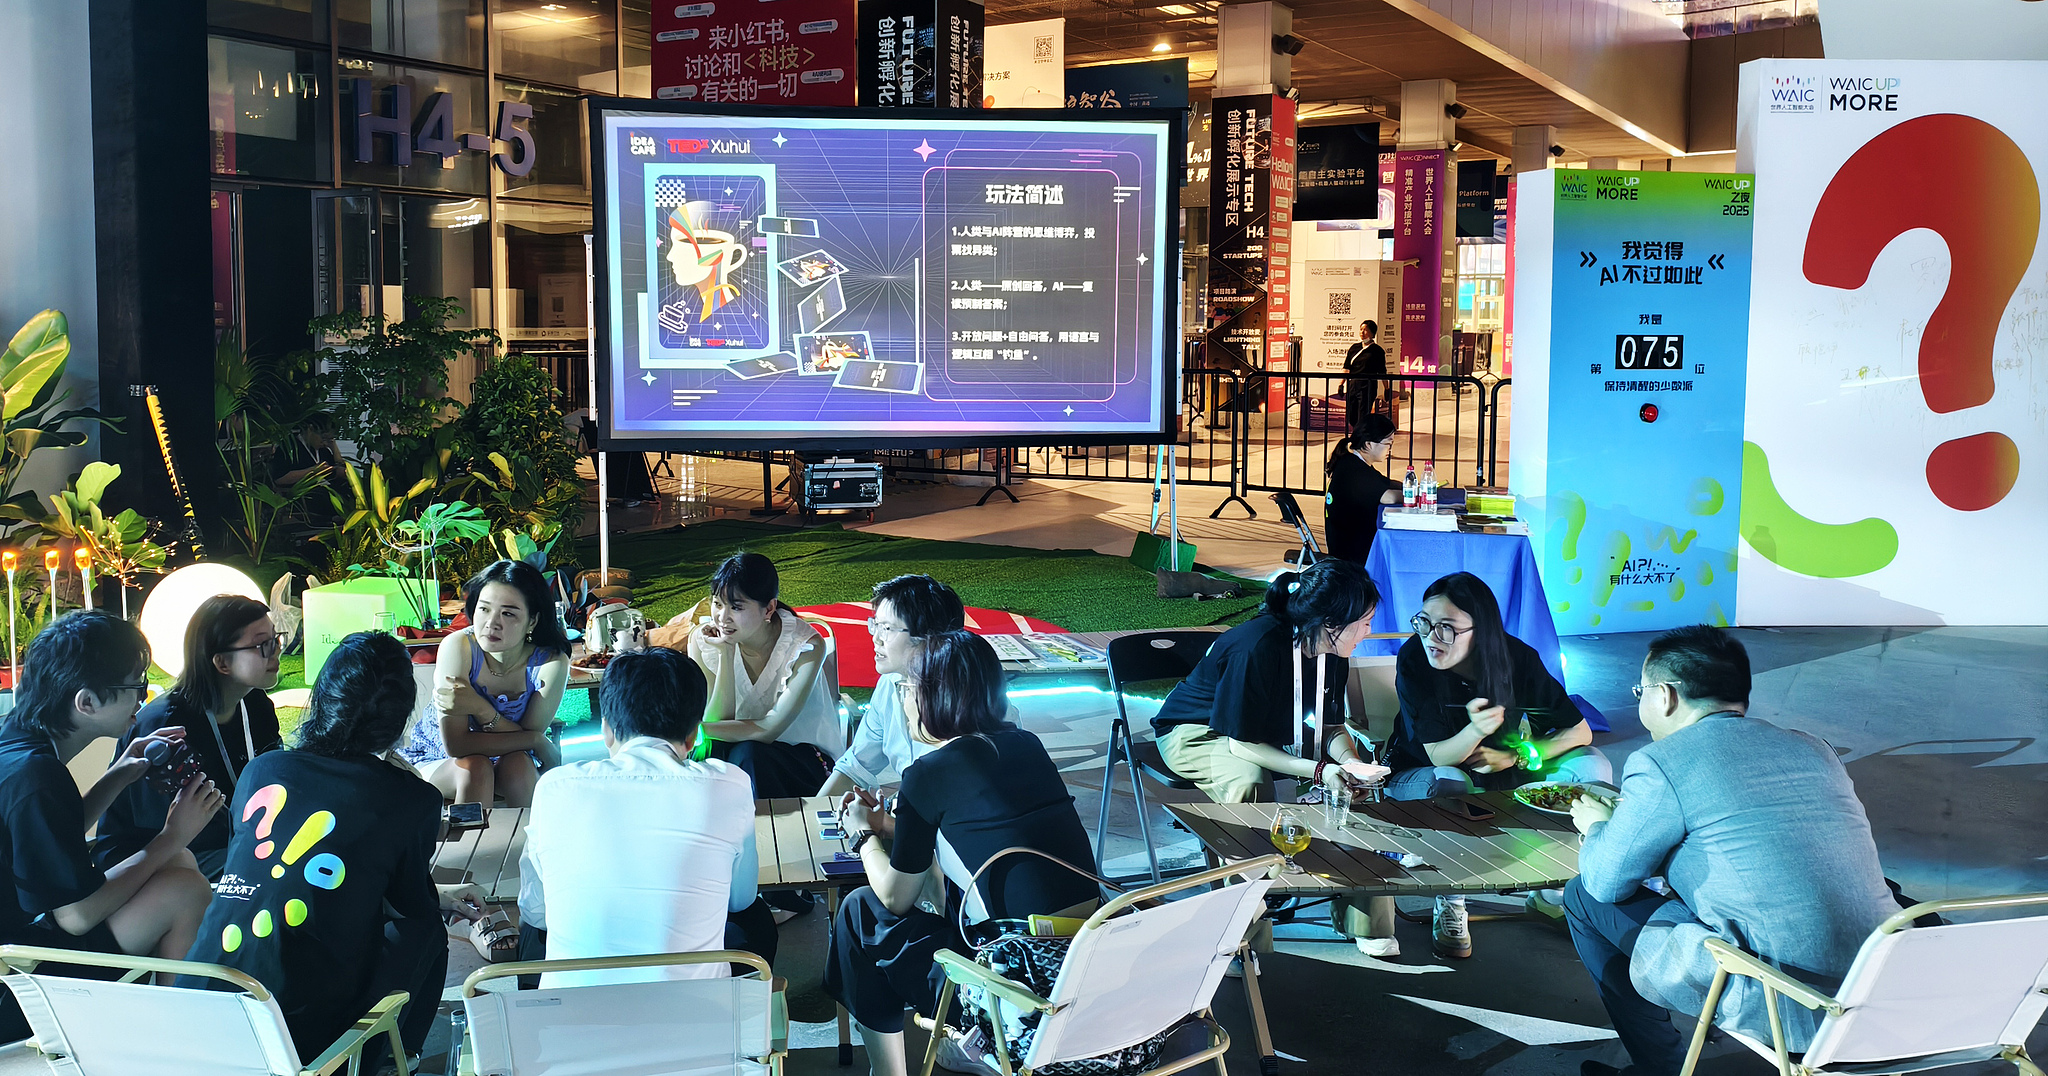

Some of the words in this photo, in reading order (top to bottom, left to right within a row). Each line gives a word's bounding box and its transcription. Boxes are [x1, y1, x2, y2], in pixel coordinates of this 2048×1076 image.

[878, 16, 896, 108] 创新孵化
[901, 15, 914, 105] FUTURE
[701, 73, 798, 103] 有关的一切
[1830, 77, 1873, 91] WAIC
[1772, 89, 1815, 102] WAIC
[1829, 94, 1898, 111] MORE
[354, 77, 537, 177] H4-5
[710, 139, 750, 154] Xuhui
[1245, 109, 1256, 170] FUTURE
[1225, 108, 1242, 228] 创新孵化展示专区
[1561, 183, 1588, 193] WAIC
[1596, 176, 1623, 186] WAIC
[1704, 178, 1733, 189] WAIC
[985, 184, 1064, 205] 玩法简述
[1243, 173, 1255, 213] TECH
[1459, 189, 1489, 197] Platform
[1596, 187, 1638, 200] MORE
[1403, 169, 1414, 236] 精准产业对接平台
[1424, 168, 1434, 235] 世界人工智能大会
[1722, 205, 1750, 216] 2025
[1246, 226, 1265, 239] H4
[1621, 241, 1684, 261] 我觉得
[1620, 336, 1679, 368] 075
[1694, 363, 1705, 375] 位
[1604, 380, 1694, 392] 保持清醒的少数派
[1609, 572, 1676, 586] 有什么大不了
